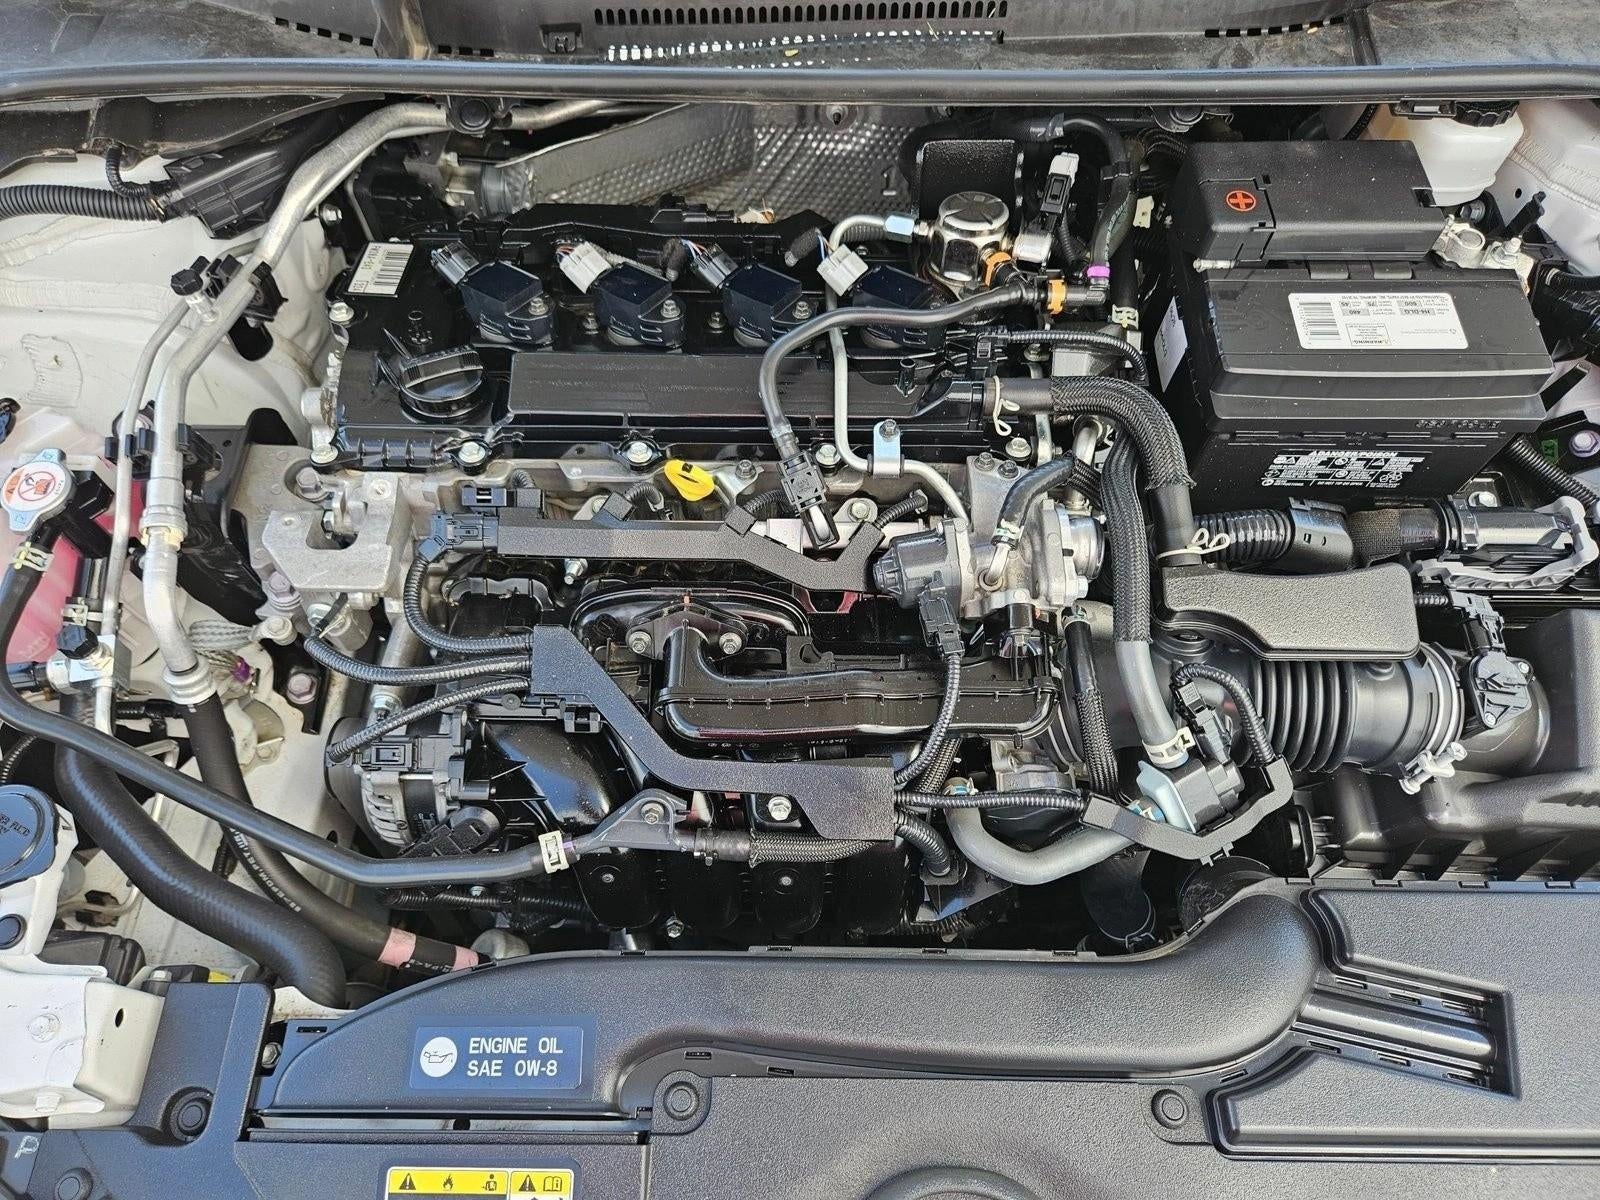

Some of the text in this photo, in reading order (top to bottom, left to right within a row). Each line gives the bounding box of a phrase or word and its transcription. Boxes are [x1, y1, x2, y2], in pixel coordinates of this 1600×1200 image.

[469, 1037, 564, 1054] ENGINE OIL
[466, 1059, 503, 1077] SAE
